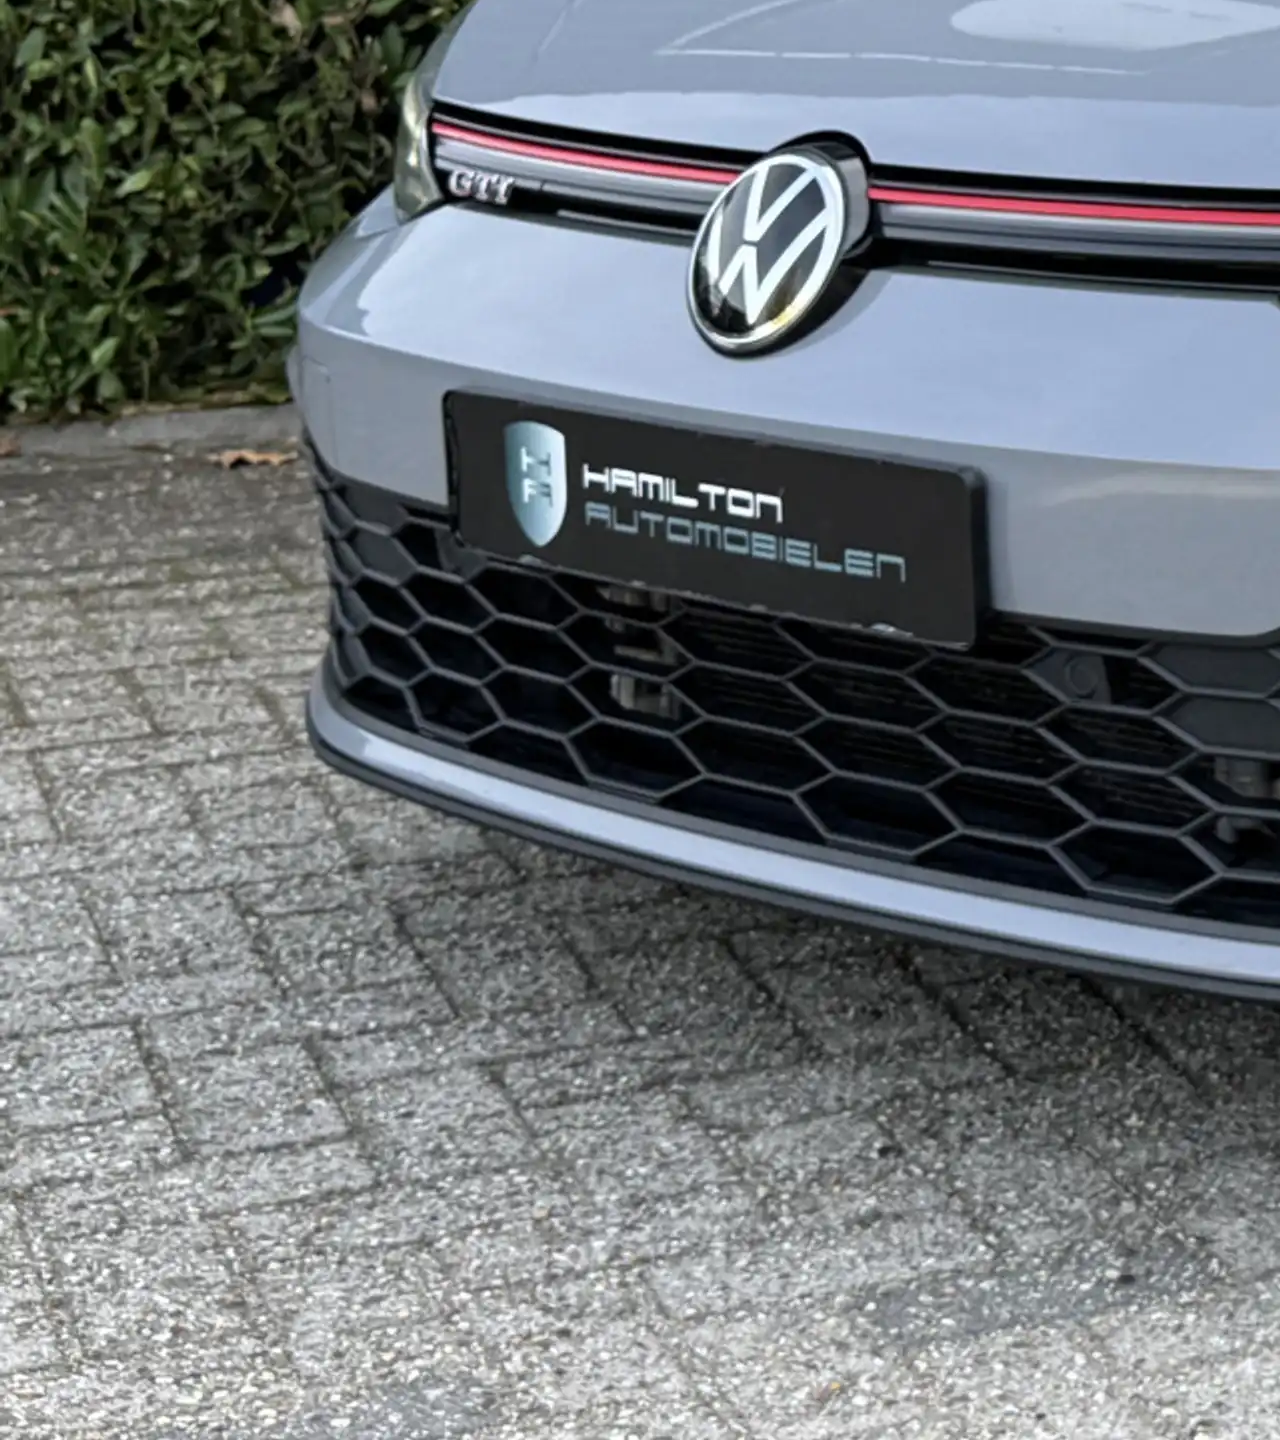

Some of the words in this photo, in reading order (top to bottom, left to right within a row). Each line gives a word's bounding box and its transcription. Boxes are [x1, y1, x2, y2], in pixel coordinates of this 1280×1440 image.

[449, 167, 515, 206] GTI
[582, 462, 783, 523] HAMILTON
[585, 501, 906, 583] AUTOMOBIELEN
